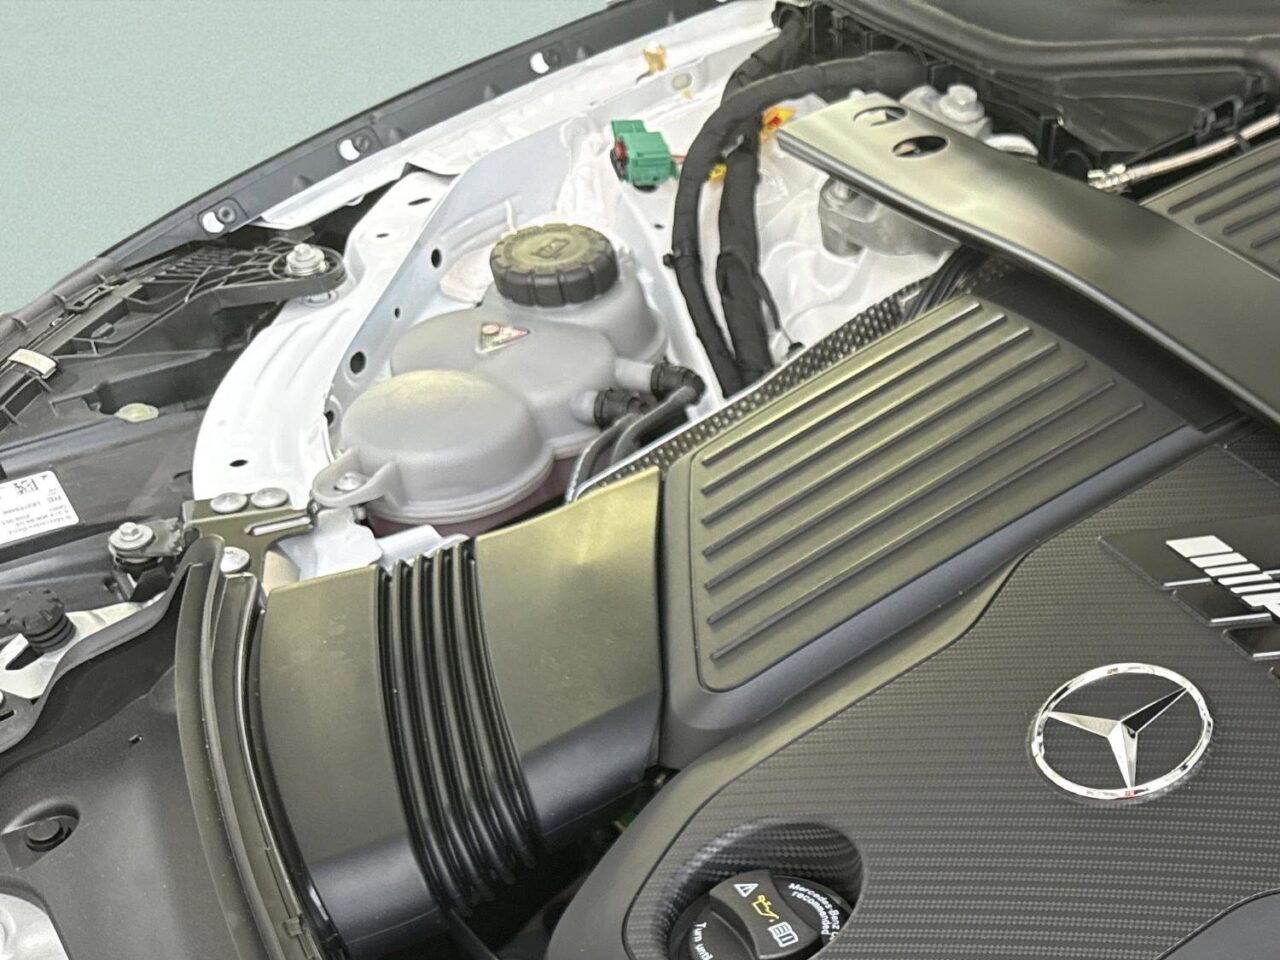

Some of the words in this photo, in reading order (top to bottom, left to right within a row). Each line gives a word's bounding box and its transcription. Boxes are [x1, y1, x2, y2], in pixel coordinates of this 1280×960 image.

[788, 882, 840, 930] Mercedes-Benz
[791, 891, 832, 935] recommended
[689, 922, 707, 943] Turn
